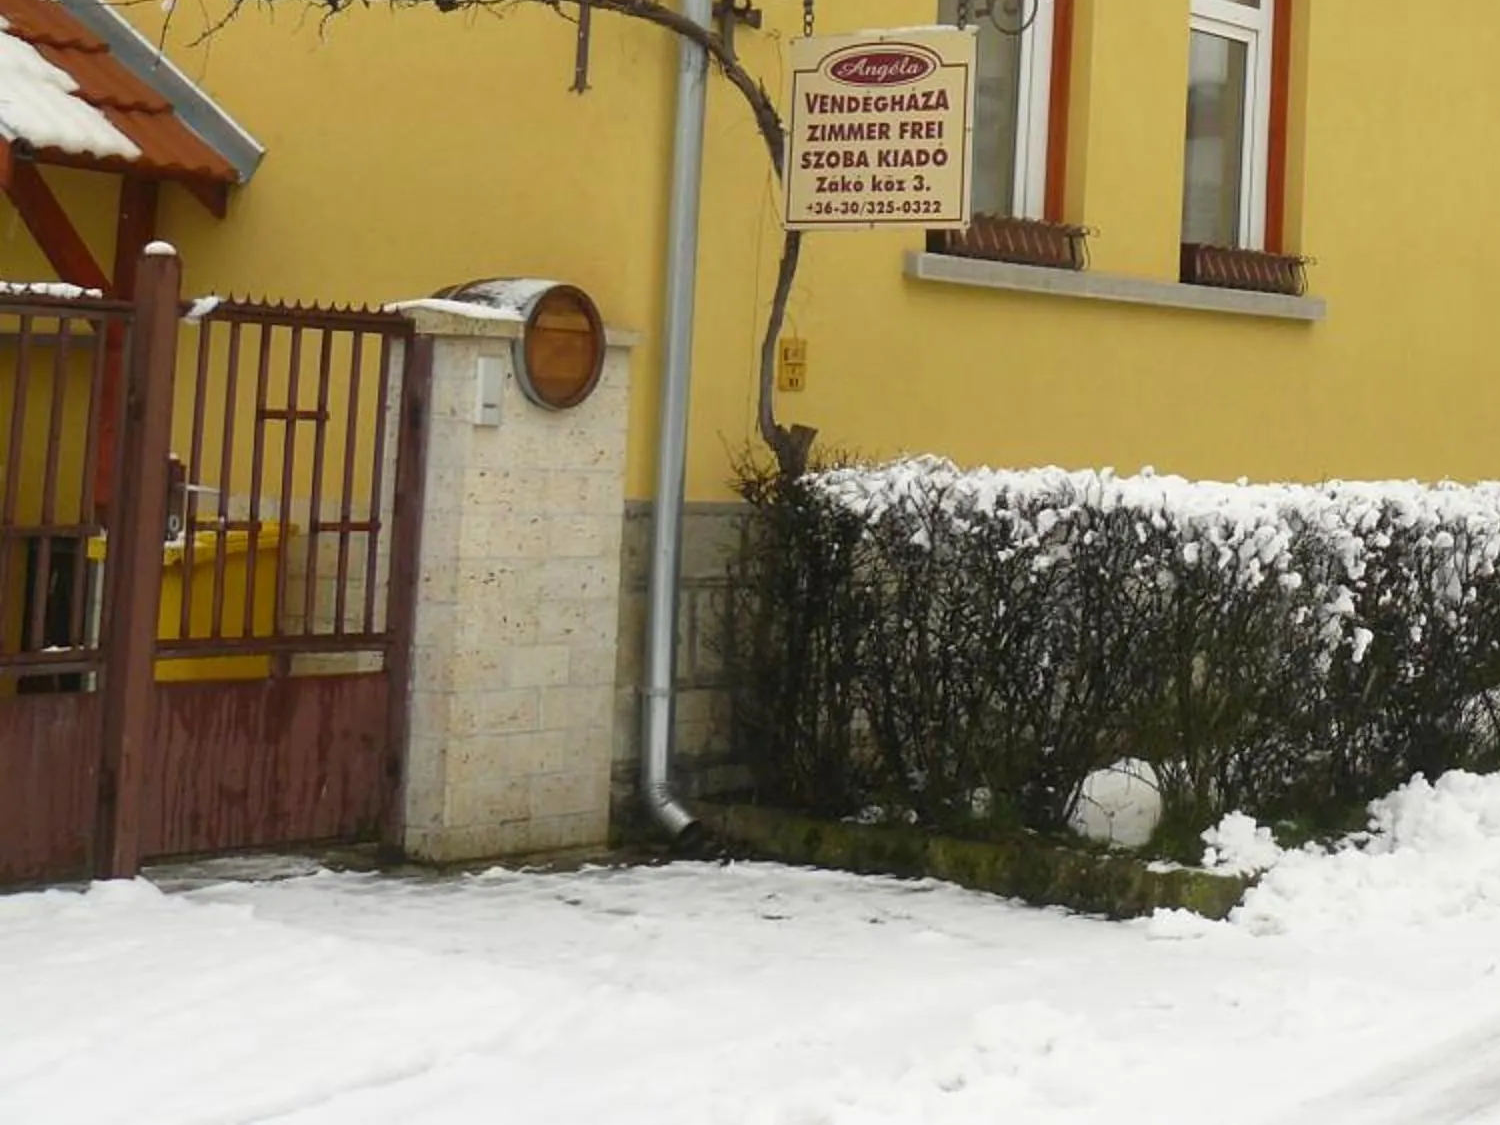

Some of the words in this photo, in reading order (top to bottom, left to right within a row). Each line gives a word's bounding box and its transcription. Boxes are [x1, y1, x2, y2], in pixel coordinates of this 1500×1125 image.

[805, 87, 950, 114] VENDÉGHÁZA
[806, 123, 890, 141] ZIMMER
[899, 121, 944, 139] FREI
[801, 151, 869, 169] SZOBA
[877, 141, 948, 167] KIADÓ
[815, 175, 864, 192] Zákó
[871, 175, 905, 191] köz
[913, 176, 931, 191] 3.
[805, 201, 942, 215] +36-30/325-0322
